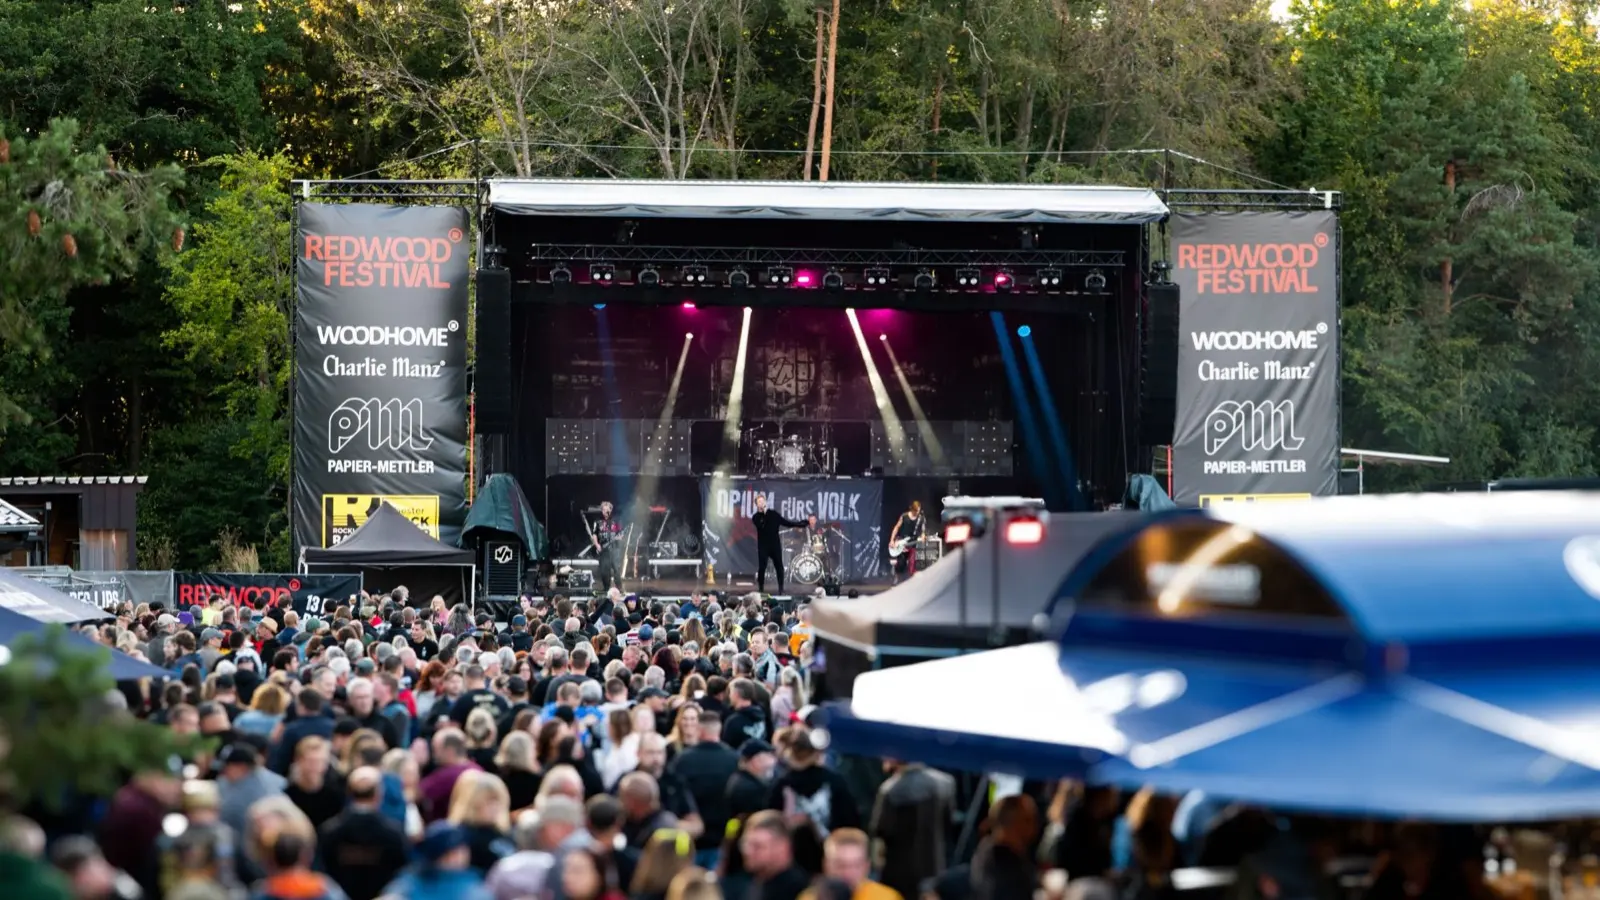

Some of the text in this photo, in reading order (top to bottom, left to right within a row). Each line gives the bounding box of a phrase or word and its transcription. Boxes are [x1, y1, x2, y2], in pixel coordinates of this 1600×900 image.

[305, 235, 452, 263] REDWOOD
[1178, 243, 1318, 269] REDWOOD
[324, 262, 451, 289] FESTIVAL
[1197, 267, 1318, 294] FESTIVAL
[317, 325, 448, 347] WOODHOME
[1191, 330, 1318, 350] WOODHOME
[323, 354, 441, 378] Charlie Manz
[1198, 359, 1310, 381] Charlie Manz
[328, 459, 435, 474] PAPIER-METTLER
[1203, 459, 1306, 474] PAPIER-METTLER
[817, 491, 861, 521] VOLK
[305, 594, 321, 612] 13
